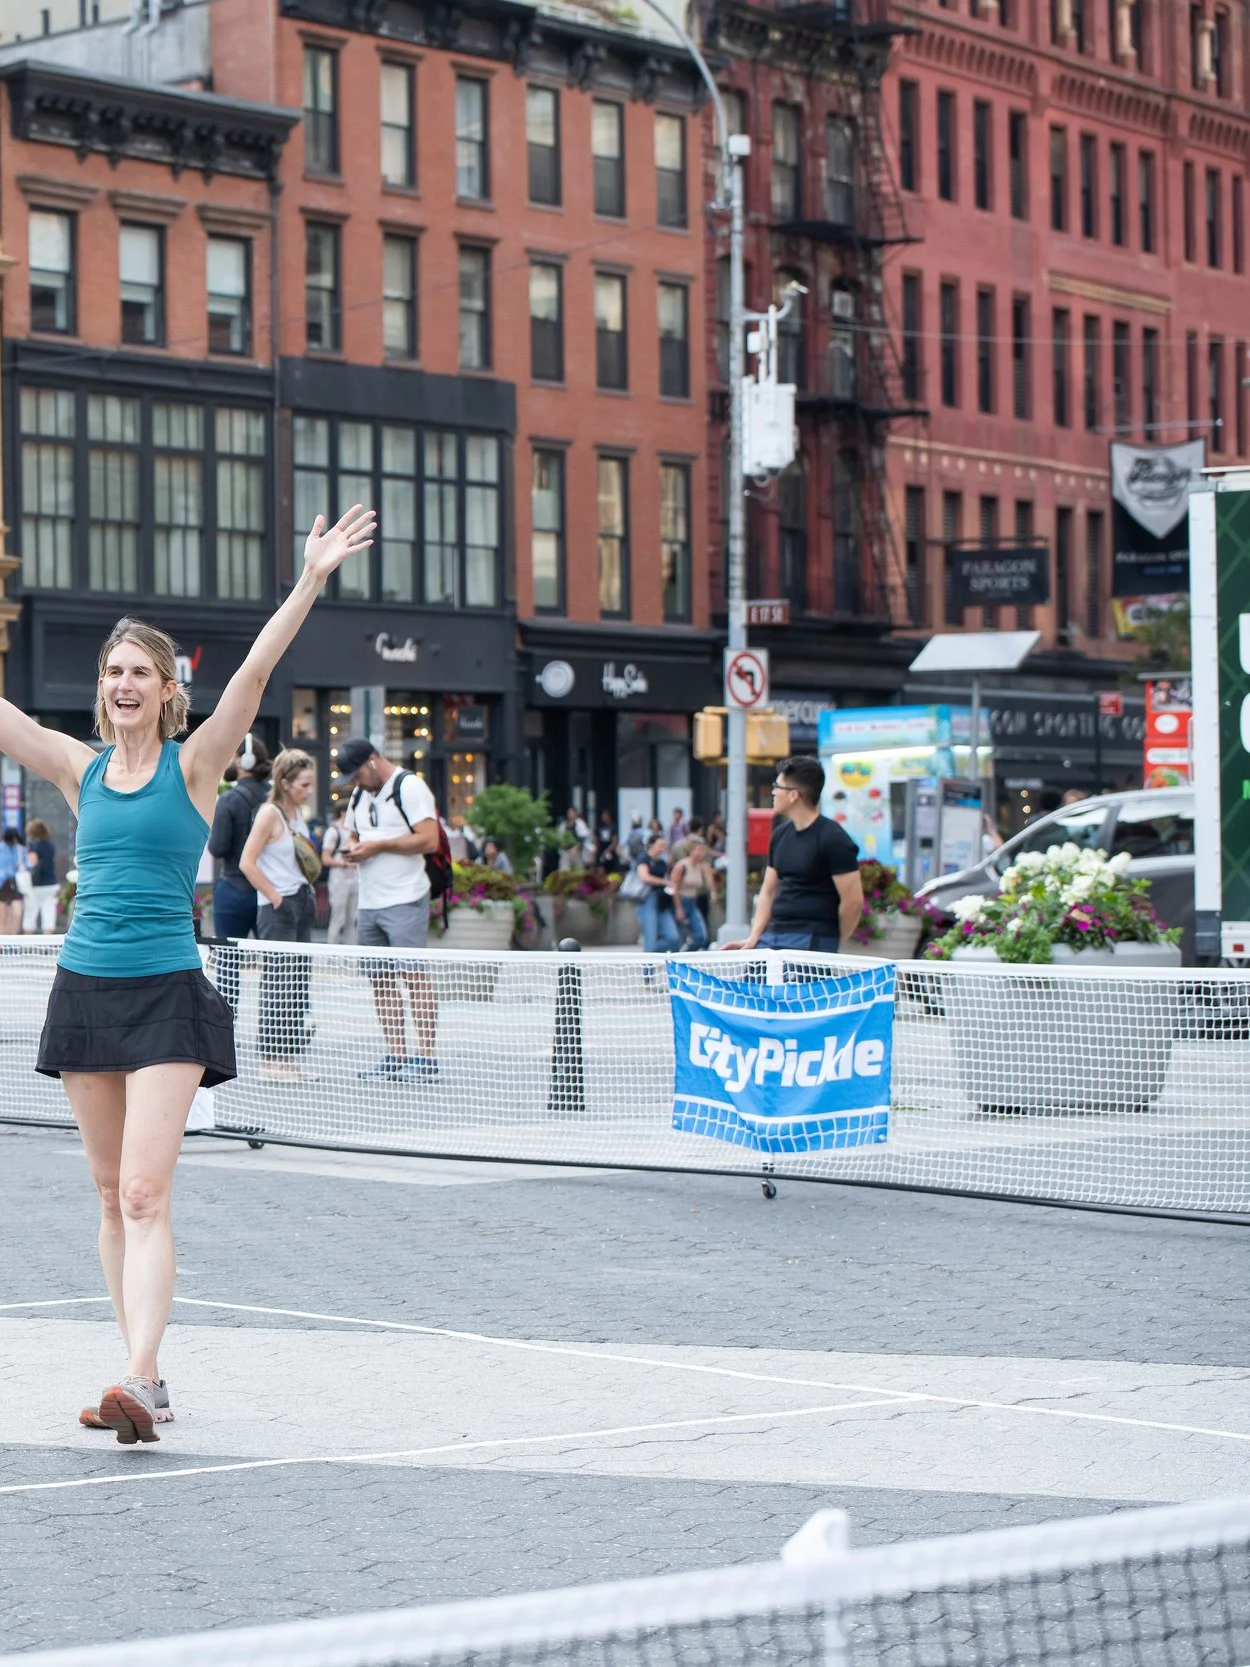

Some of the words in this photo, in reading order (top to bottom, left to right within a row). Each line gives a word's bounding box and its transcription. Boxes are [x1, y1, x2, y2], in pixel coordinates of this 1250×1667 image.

[962, 559, 1037, 575] PARAGON
[969, 577, 1029, 592] SPORTS
[689, 1021, 885, 1093] CityPickle
